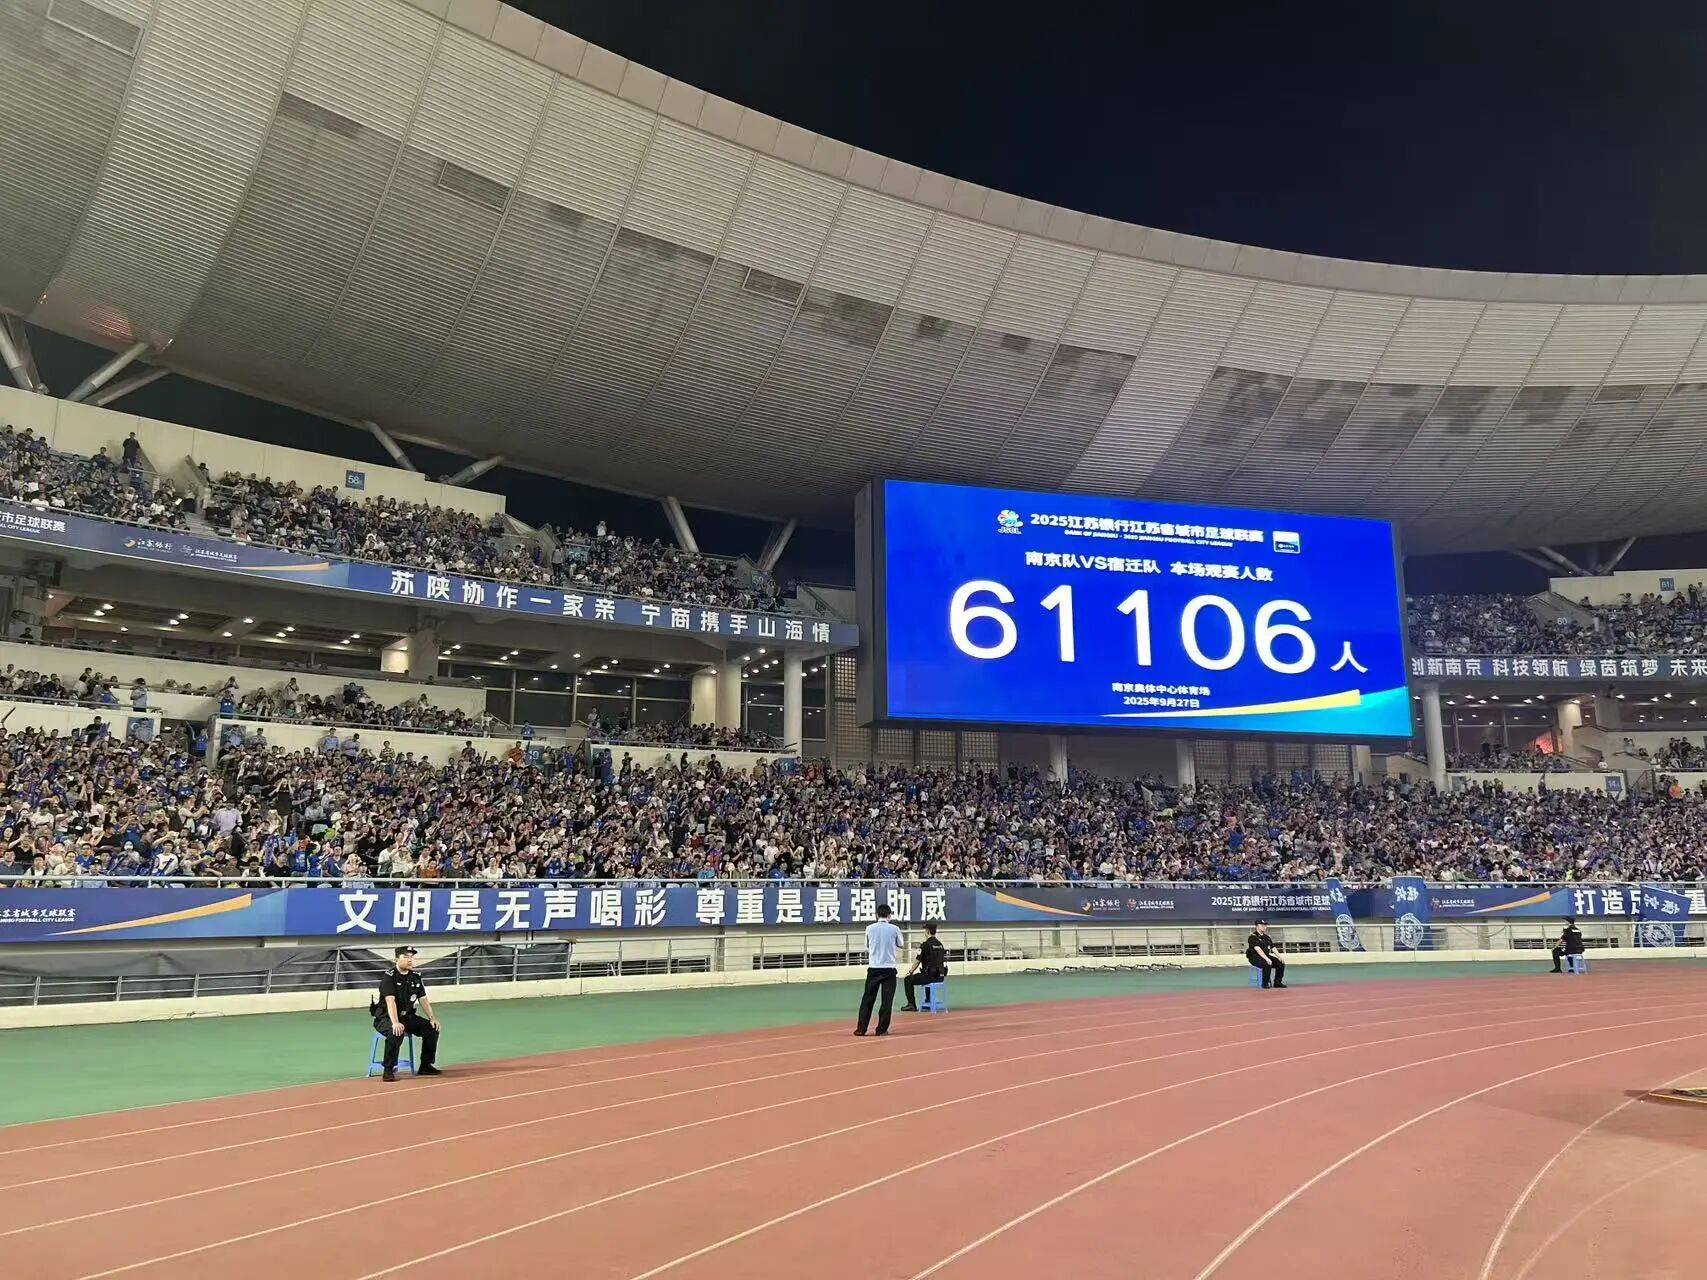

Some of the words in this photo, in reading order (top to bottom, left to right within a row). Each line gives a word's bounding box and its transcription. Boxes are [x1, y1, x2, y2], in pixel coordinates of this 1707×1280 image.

[0, 511, 66, 532] 市足球联赛
[1025, 551, 1161, 574] 南京队VS宿迁队
[1170, 561, 1274, 582] 本场观赛人数
[390, 570, 616, 621] 苏陕协作一家亲
[641, 604, 831, 643] 宁商携手山海情
[1492, 658, 1570, 677] 科技领航
[1579, 658, 1659, 677] 绿茵筑梦
[1111, 682, 1211, 697] 南京奥体中心体育场
[1123, 696, 1200, 708] 2025年9月27日
[0, 909, 76, 918] 苏省城市足球联赛
[336, 888, 666, 934] 文明是无声喝彩
[696, 887, 947, 925] 尊重是最强助威
